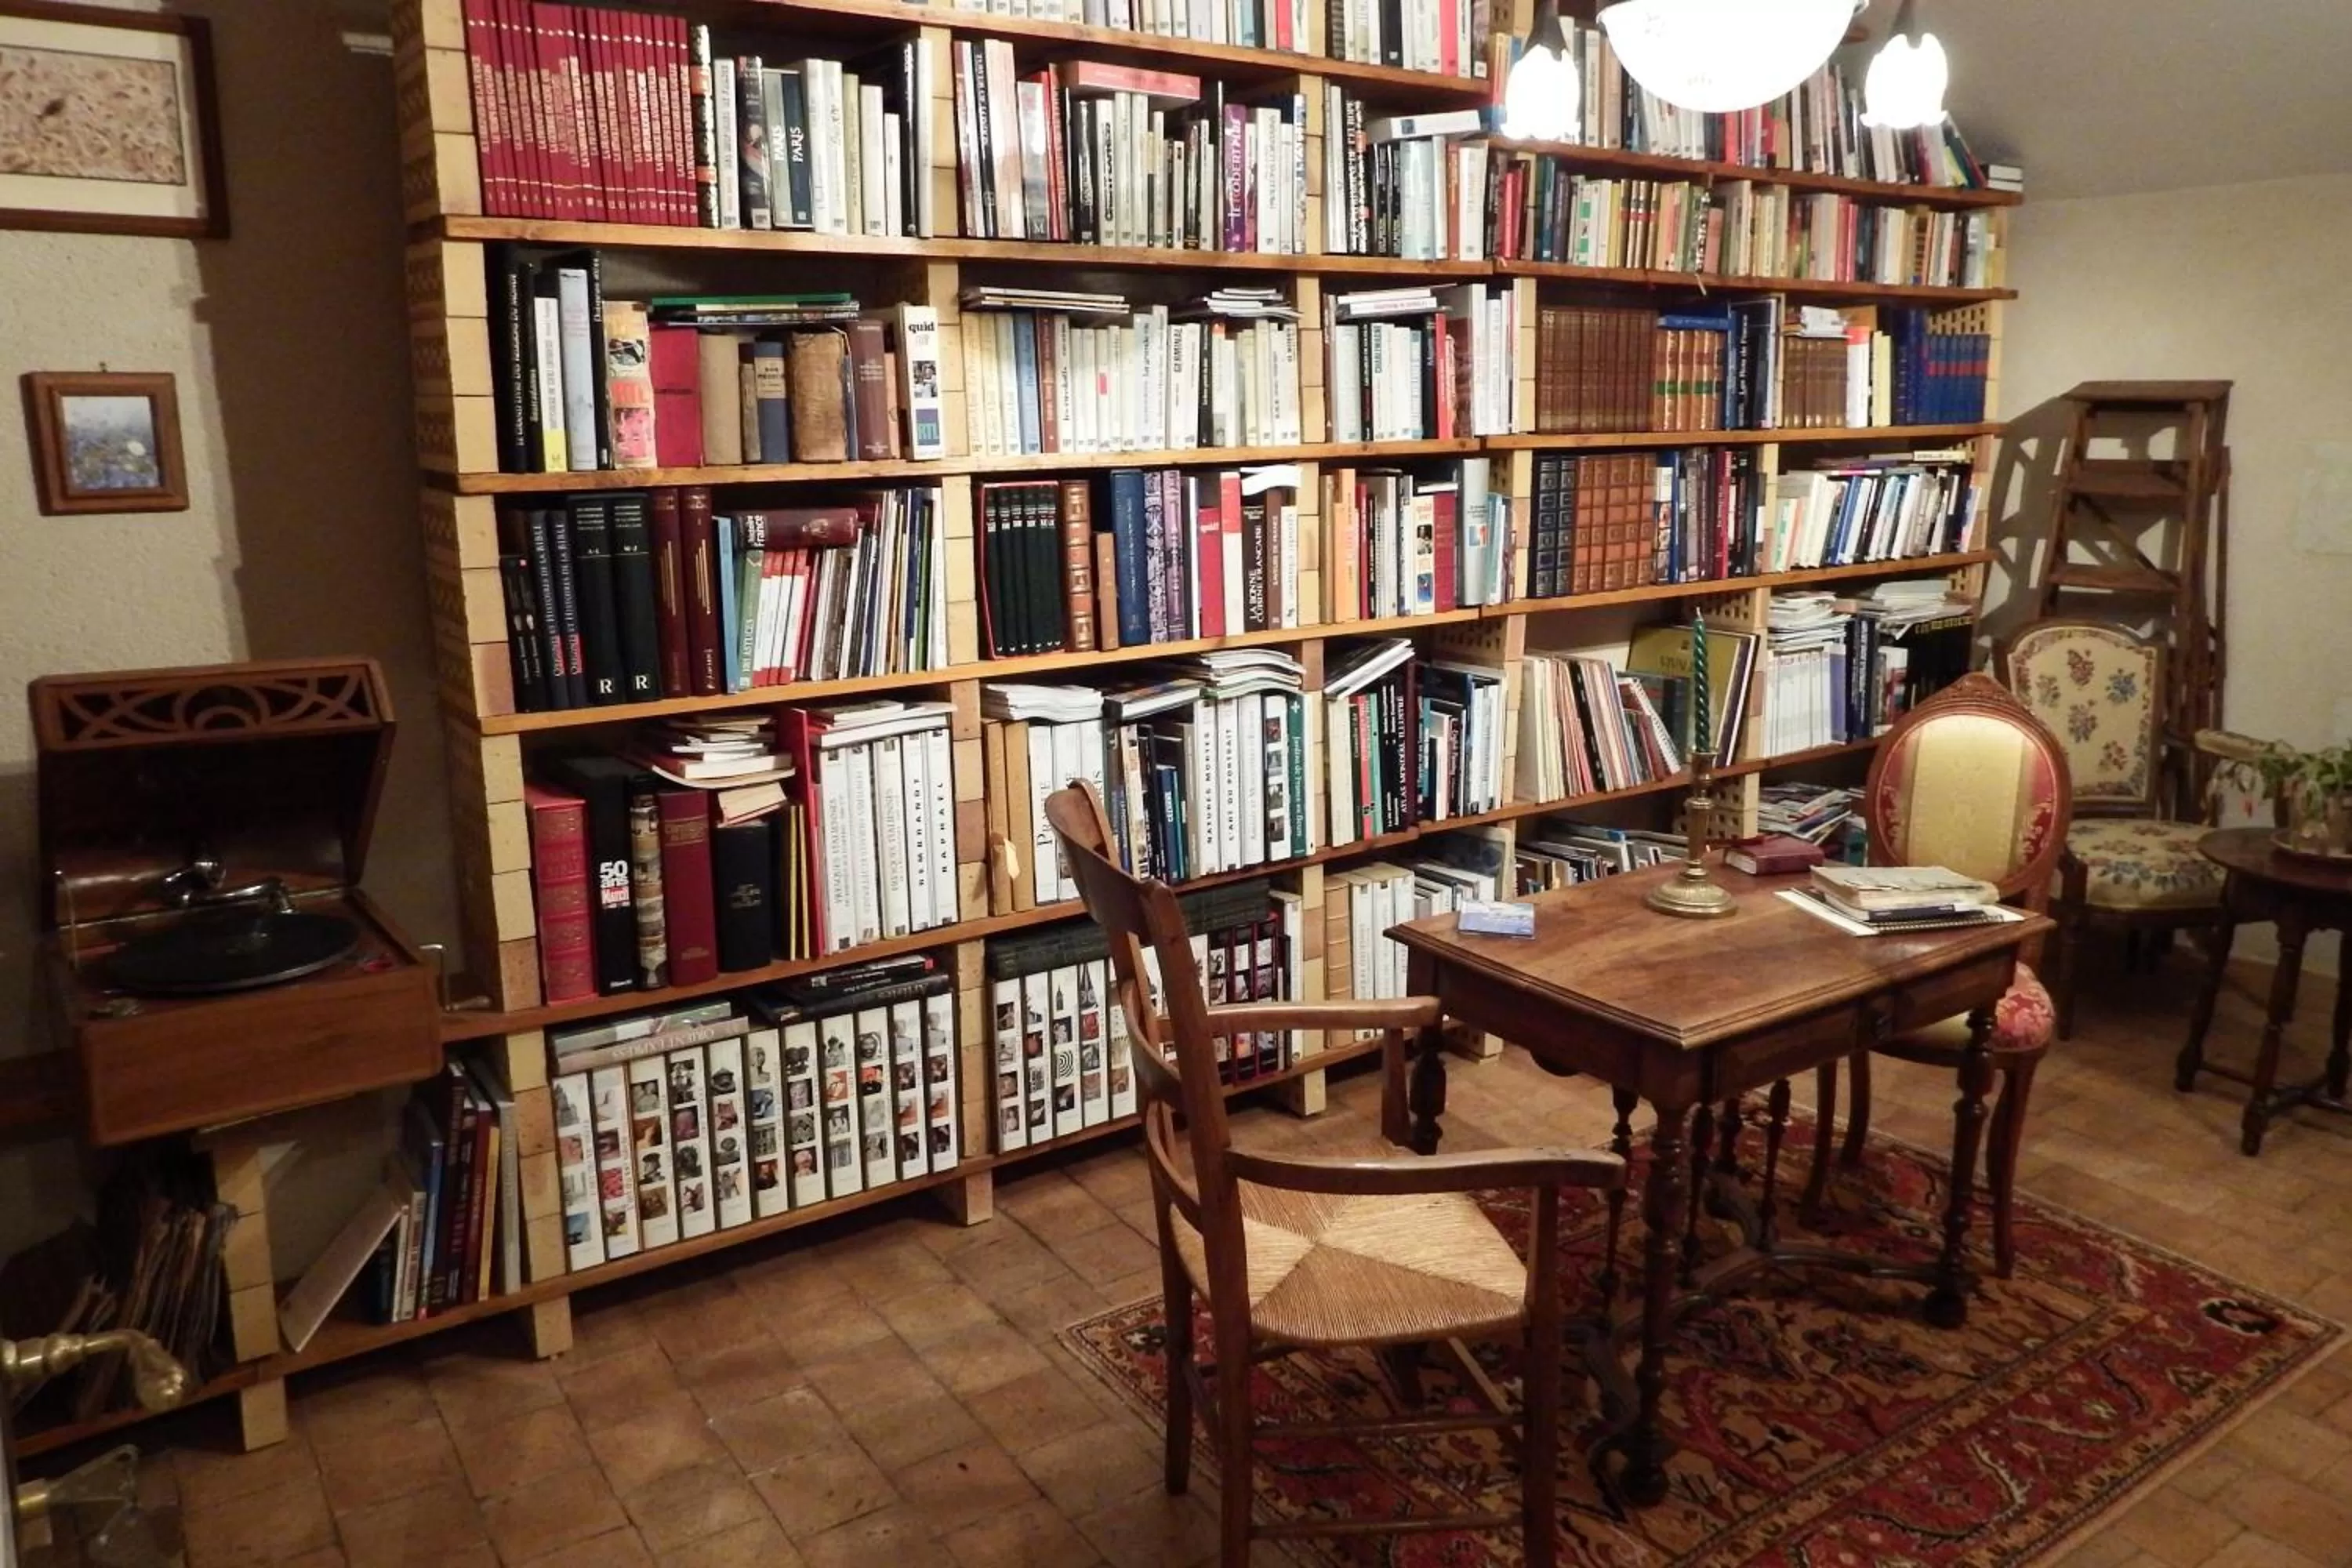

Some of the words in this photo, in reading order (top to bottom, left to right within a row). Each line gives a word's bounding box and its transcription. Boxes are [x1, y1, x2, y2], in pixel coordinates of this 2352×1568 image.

[771, 125, 786, 162] PARIS
[790, 126, 804, 163] PARIS
[909, 321, 935, 333] quid
[917, 423, 938, 441] RTL
[754, 514, 765, 547] France
[1256, 583, 1265, 622] CUISINE
[1250, 607, 1257, 619] LA
[743, 619, 754, 656] ASTUCES
[599, 678, 613, 694] R
[635, 674, 648, 690] R
[1227, 789, 1233, 804] DU
[913, 778, 925, 887] REMBRANDT
[600, 860, 629, 878] 50
